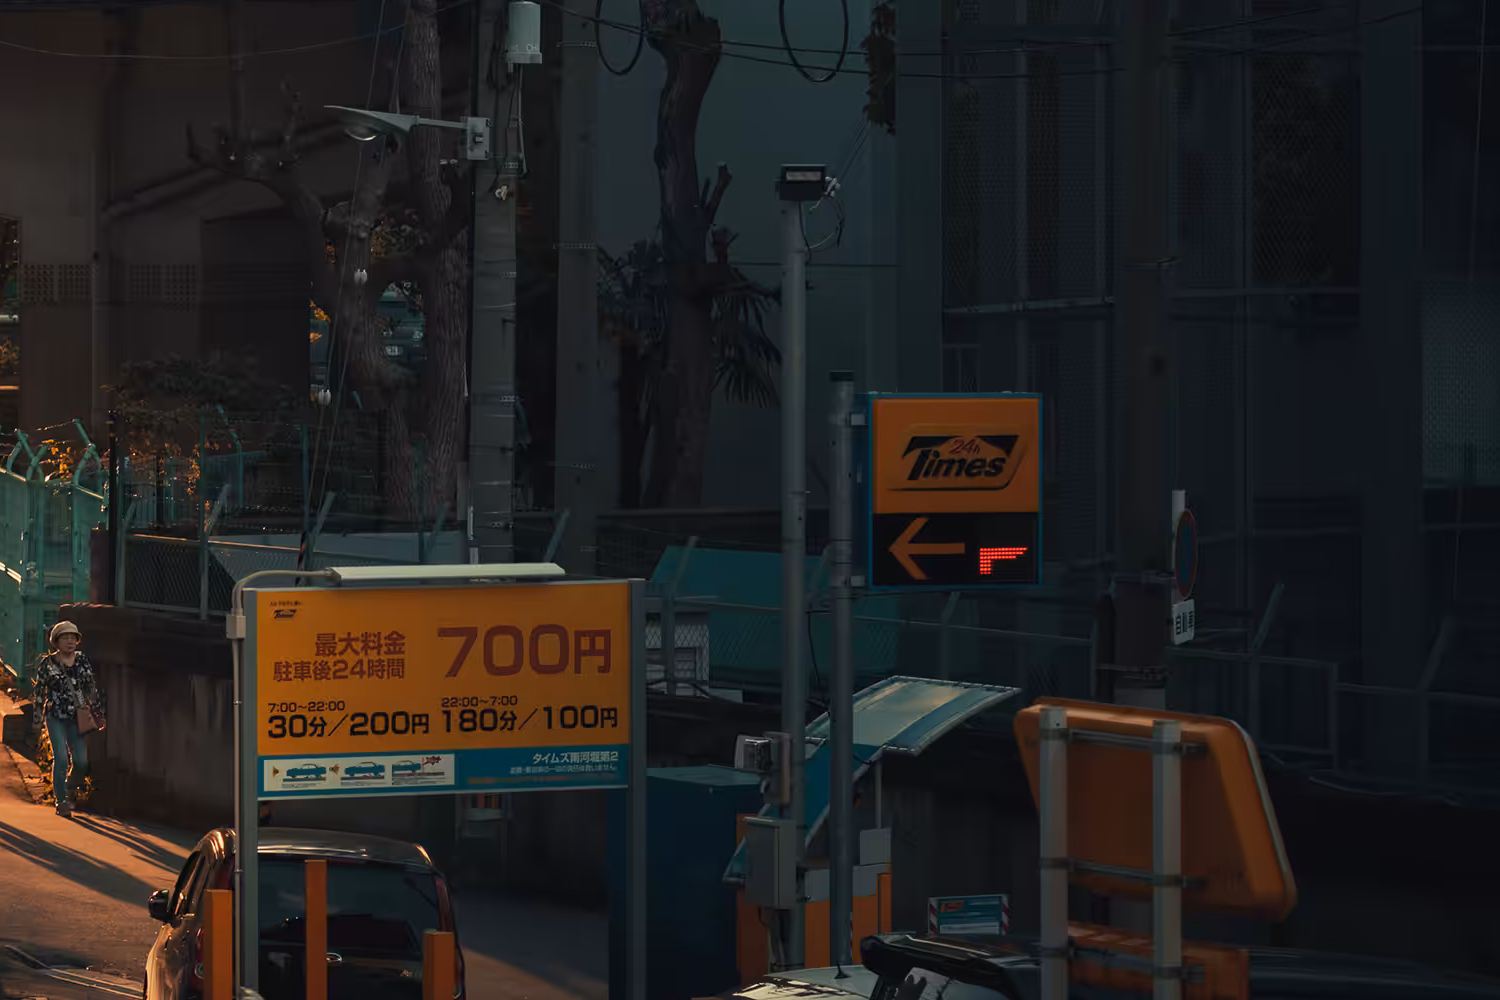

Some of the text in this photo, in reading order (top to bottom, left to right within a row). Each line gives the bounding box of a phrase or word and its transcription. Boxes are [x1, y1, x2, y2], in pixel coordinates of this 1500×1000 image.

[905, 447, 1007, 481] Times
[314, 630, 406, 657] 最大料金
[437, 624, 612, 678] 700円
[273, 658, 405, 682] 駐車後24時間
